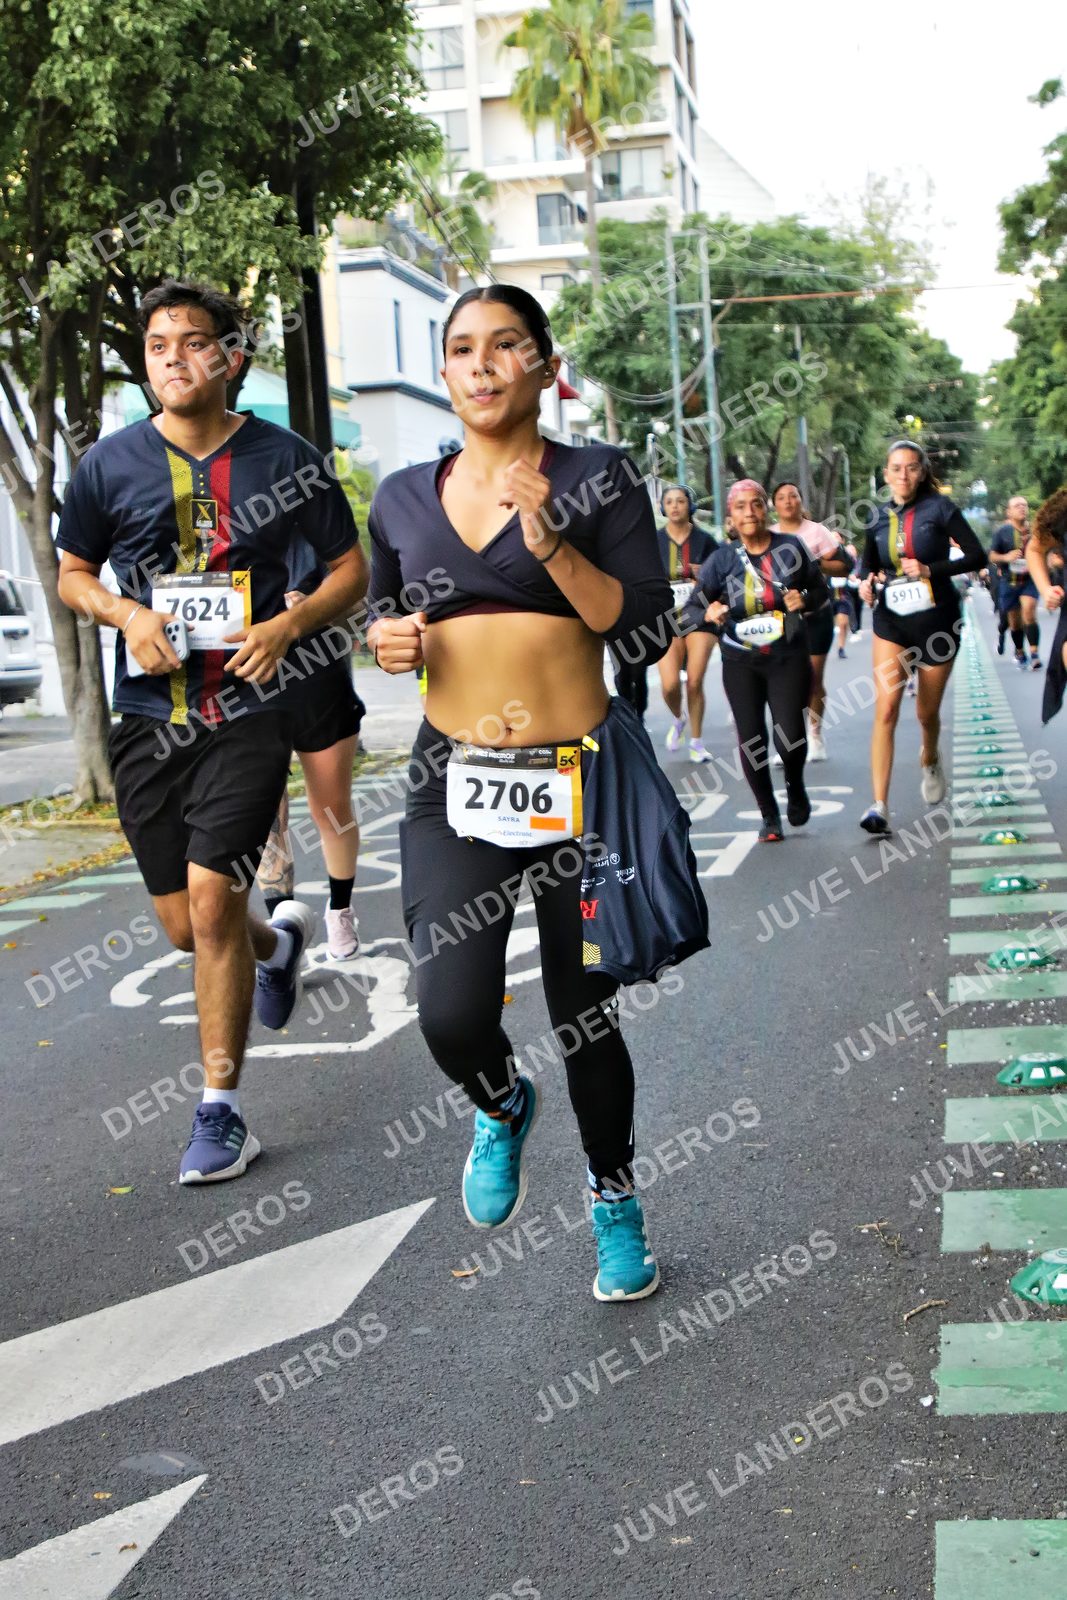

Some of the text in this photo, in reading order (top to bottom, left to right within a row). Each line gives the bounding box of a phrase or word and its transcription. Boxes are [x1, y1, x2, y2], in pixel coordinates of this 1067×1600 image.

[892, 587, 922, 603] 5911
[166, 597, 230, 622] 7624
[559, 755, 576, 767] 5K
[465, 777, 552, 814] 2706
